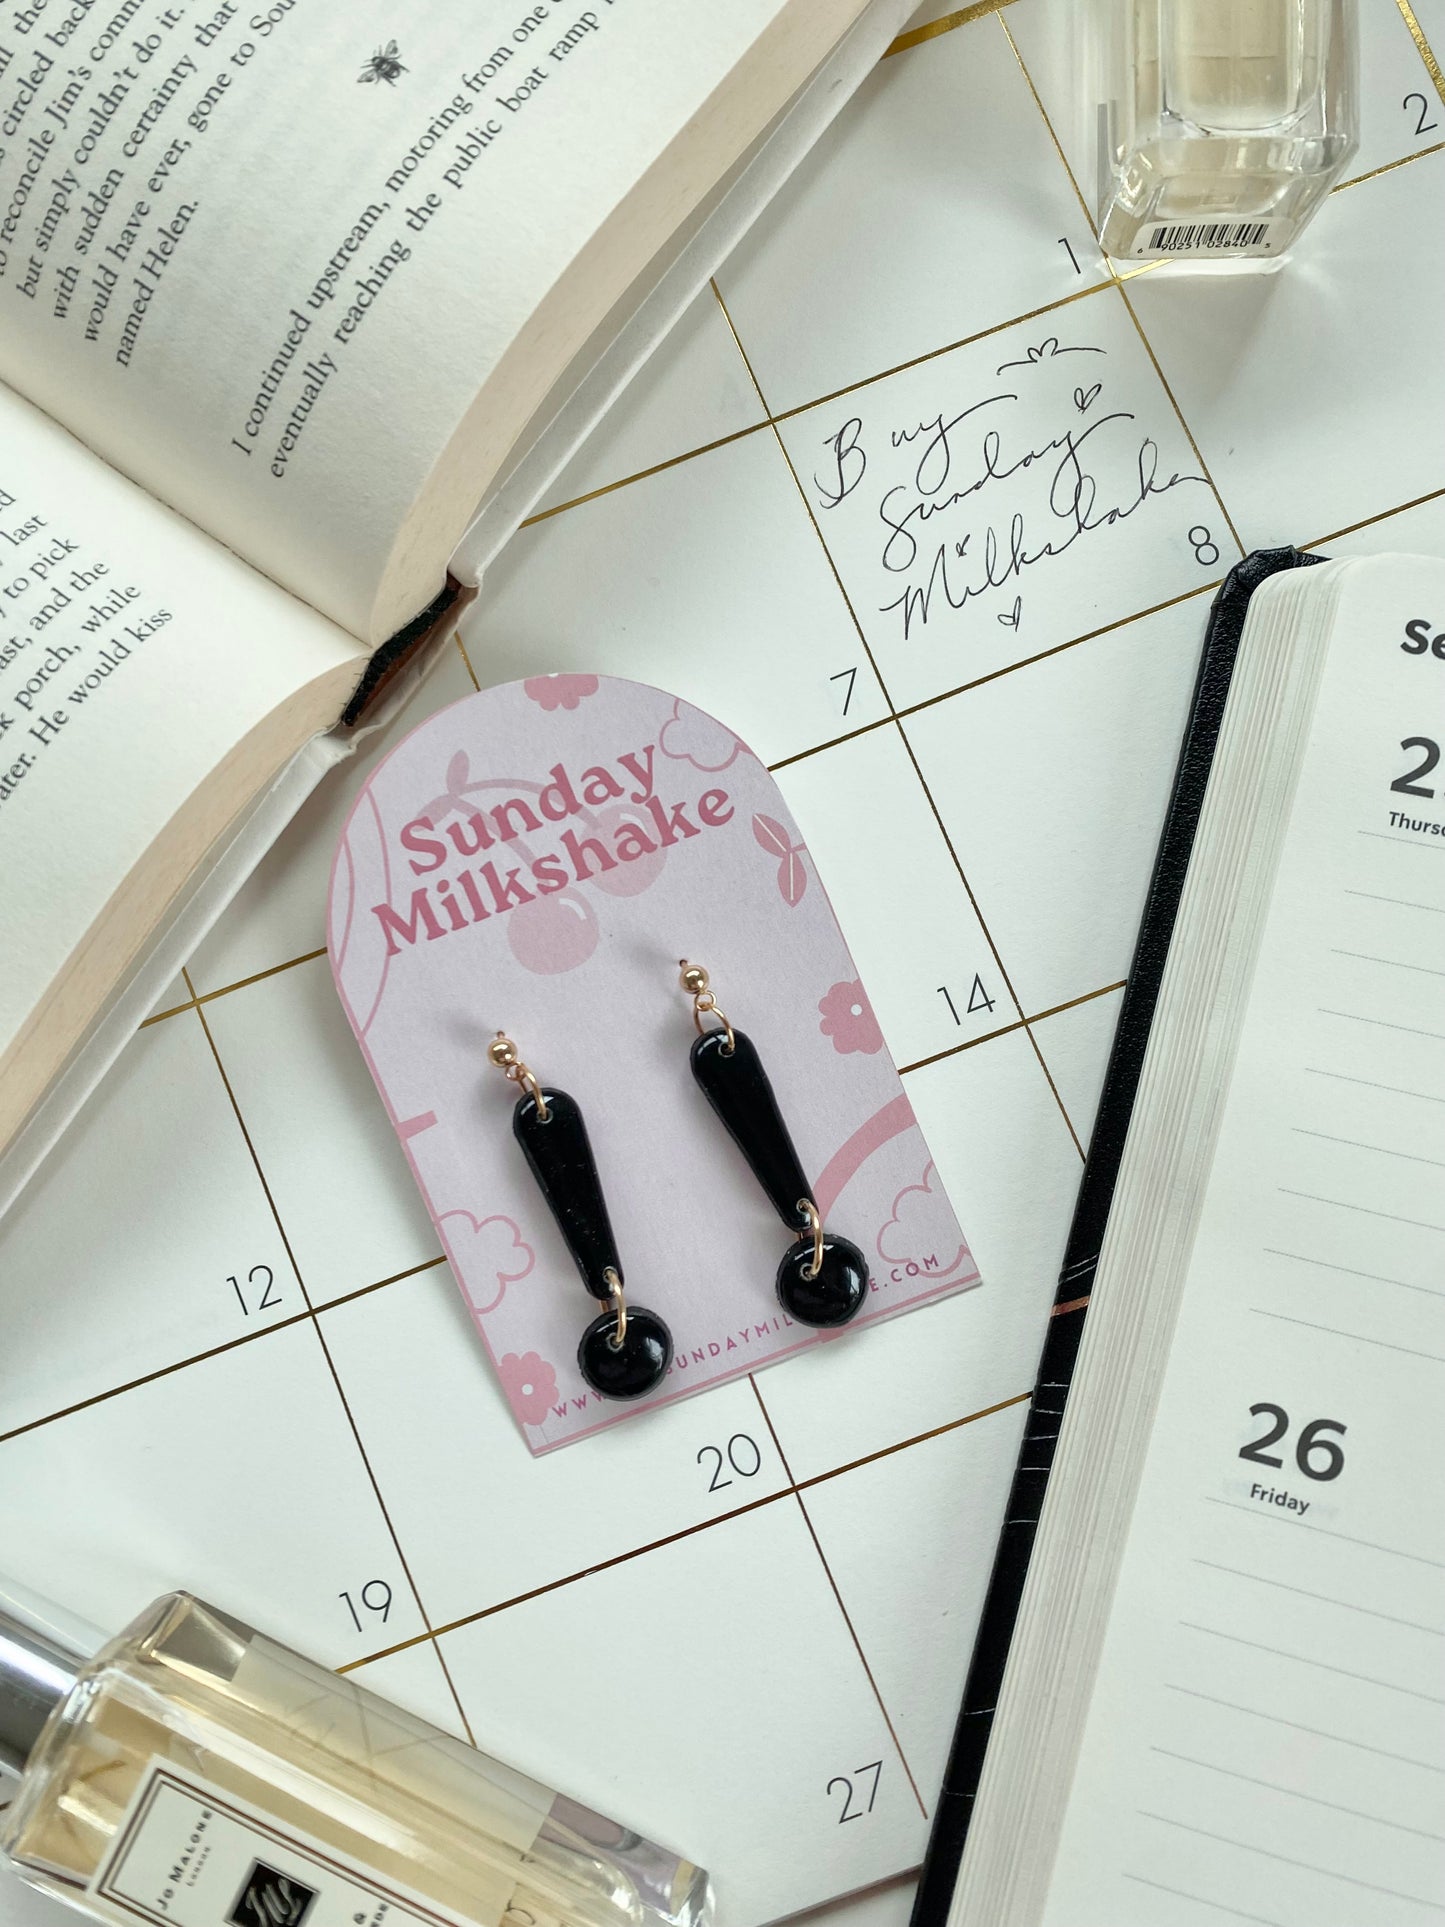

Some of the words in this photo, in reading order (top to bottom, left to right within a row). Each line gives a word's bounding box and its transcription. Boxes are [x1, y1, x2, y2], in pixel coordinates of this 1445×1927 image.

[3, 50, 54, 136] circled
[1402, 92, 1438, 136] 2
[1, 130, 56, 244] reconcile
[44, 66, 92, 129] Jim's
[16, 255, 43, 299] but
[35, 169, 81, 252] simply
[74, 67, 139, 164] couldn't
[132, 34, 162, 63] do
[156, 9, 185, 29] it.
[53, 265, 81, 319] with
[75, 169, 124, 255] sudden
[122, 54, 198, 157] certainty
[195, 0, 238, 47] that
[84, 263, 119, 342] would
[105, 201, 151, 263] have
[148, 139, 191, 193] ever,
[187, 73, 232, 132] gone
[230, 42, 256, 66] to
[231, 437, 252, 456] I
[244, 309, 311, 438] continued
[307, 200, 391, 308] upstream,
[385, 94, 473, 193] motoring
[462, 46, 514, 94] from
[512, 5, 549, 43] one
[270, 352, 339, 479] eventually
[334, 239, 412, 345] reaching
[406, 191, 442, 233] the
[443, 118, 503, 189] public
[496, 66, 549, 112] boat
[549, 11, 600, 61] ramp
[1057, 237, 1081, 275] 1
[1161, 241, 1201, 252] 90251
[1207, 240, 1249, 249] 02840
[116, 278, 155, 367] named
[142, 201, 199, 281] Helen.
[814, 394, 1018, 509] Buy
[880, 412, 1135, 571] Sunday
[0, 515, 47, 546] last
[3, 576, 30, 599] to
[30, 537, 80, 580] pick
[1188, 525, 1220, 566] 8
[29, 587, 72, 631] and
[70, 561, 110, 592] the
[14, 642, 82, 711] porch,
[81, 583, 142, 634] while
[0, 752, 37, 800] ater.
[29, 709, 70, 746] He
[68, 639, 131, 705] would
[125, 607, 173, 643] kiss
[830, 668, 858, 716] 7
[400, 744, 656, 876] Sunday
[371, 788, 735, 957] Milkshake
[937, 972, 996, 1026] 14
[226, 1265, 283, 1316] 12
[696, 1433, 761, 1493] 20
[1238, 1402, 1348, 1482] 26
[1250, 1483, 1310, 1516] Friday
[339, 1580, 392, 1632] 19
[827, 1760, 883, 1824] 27
